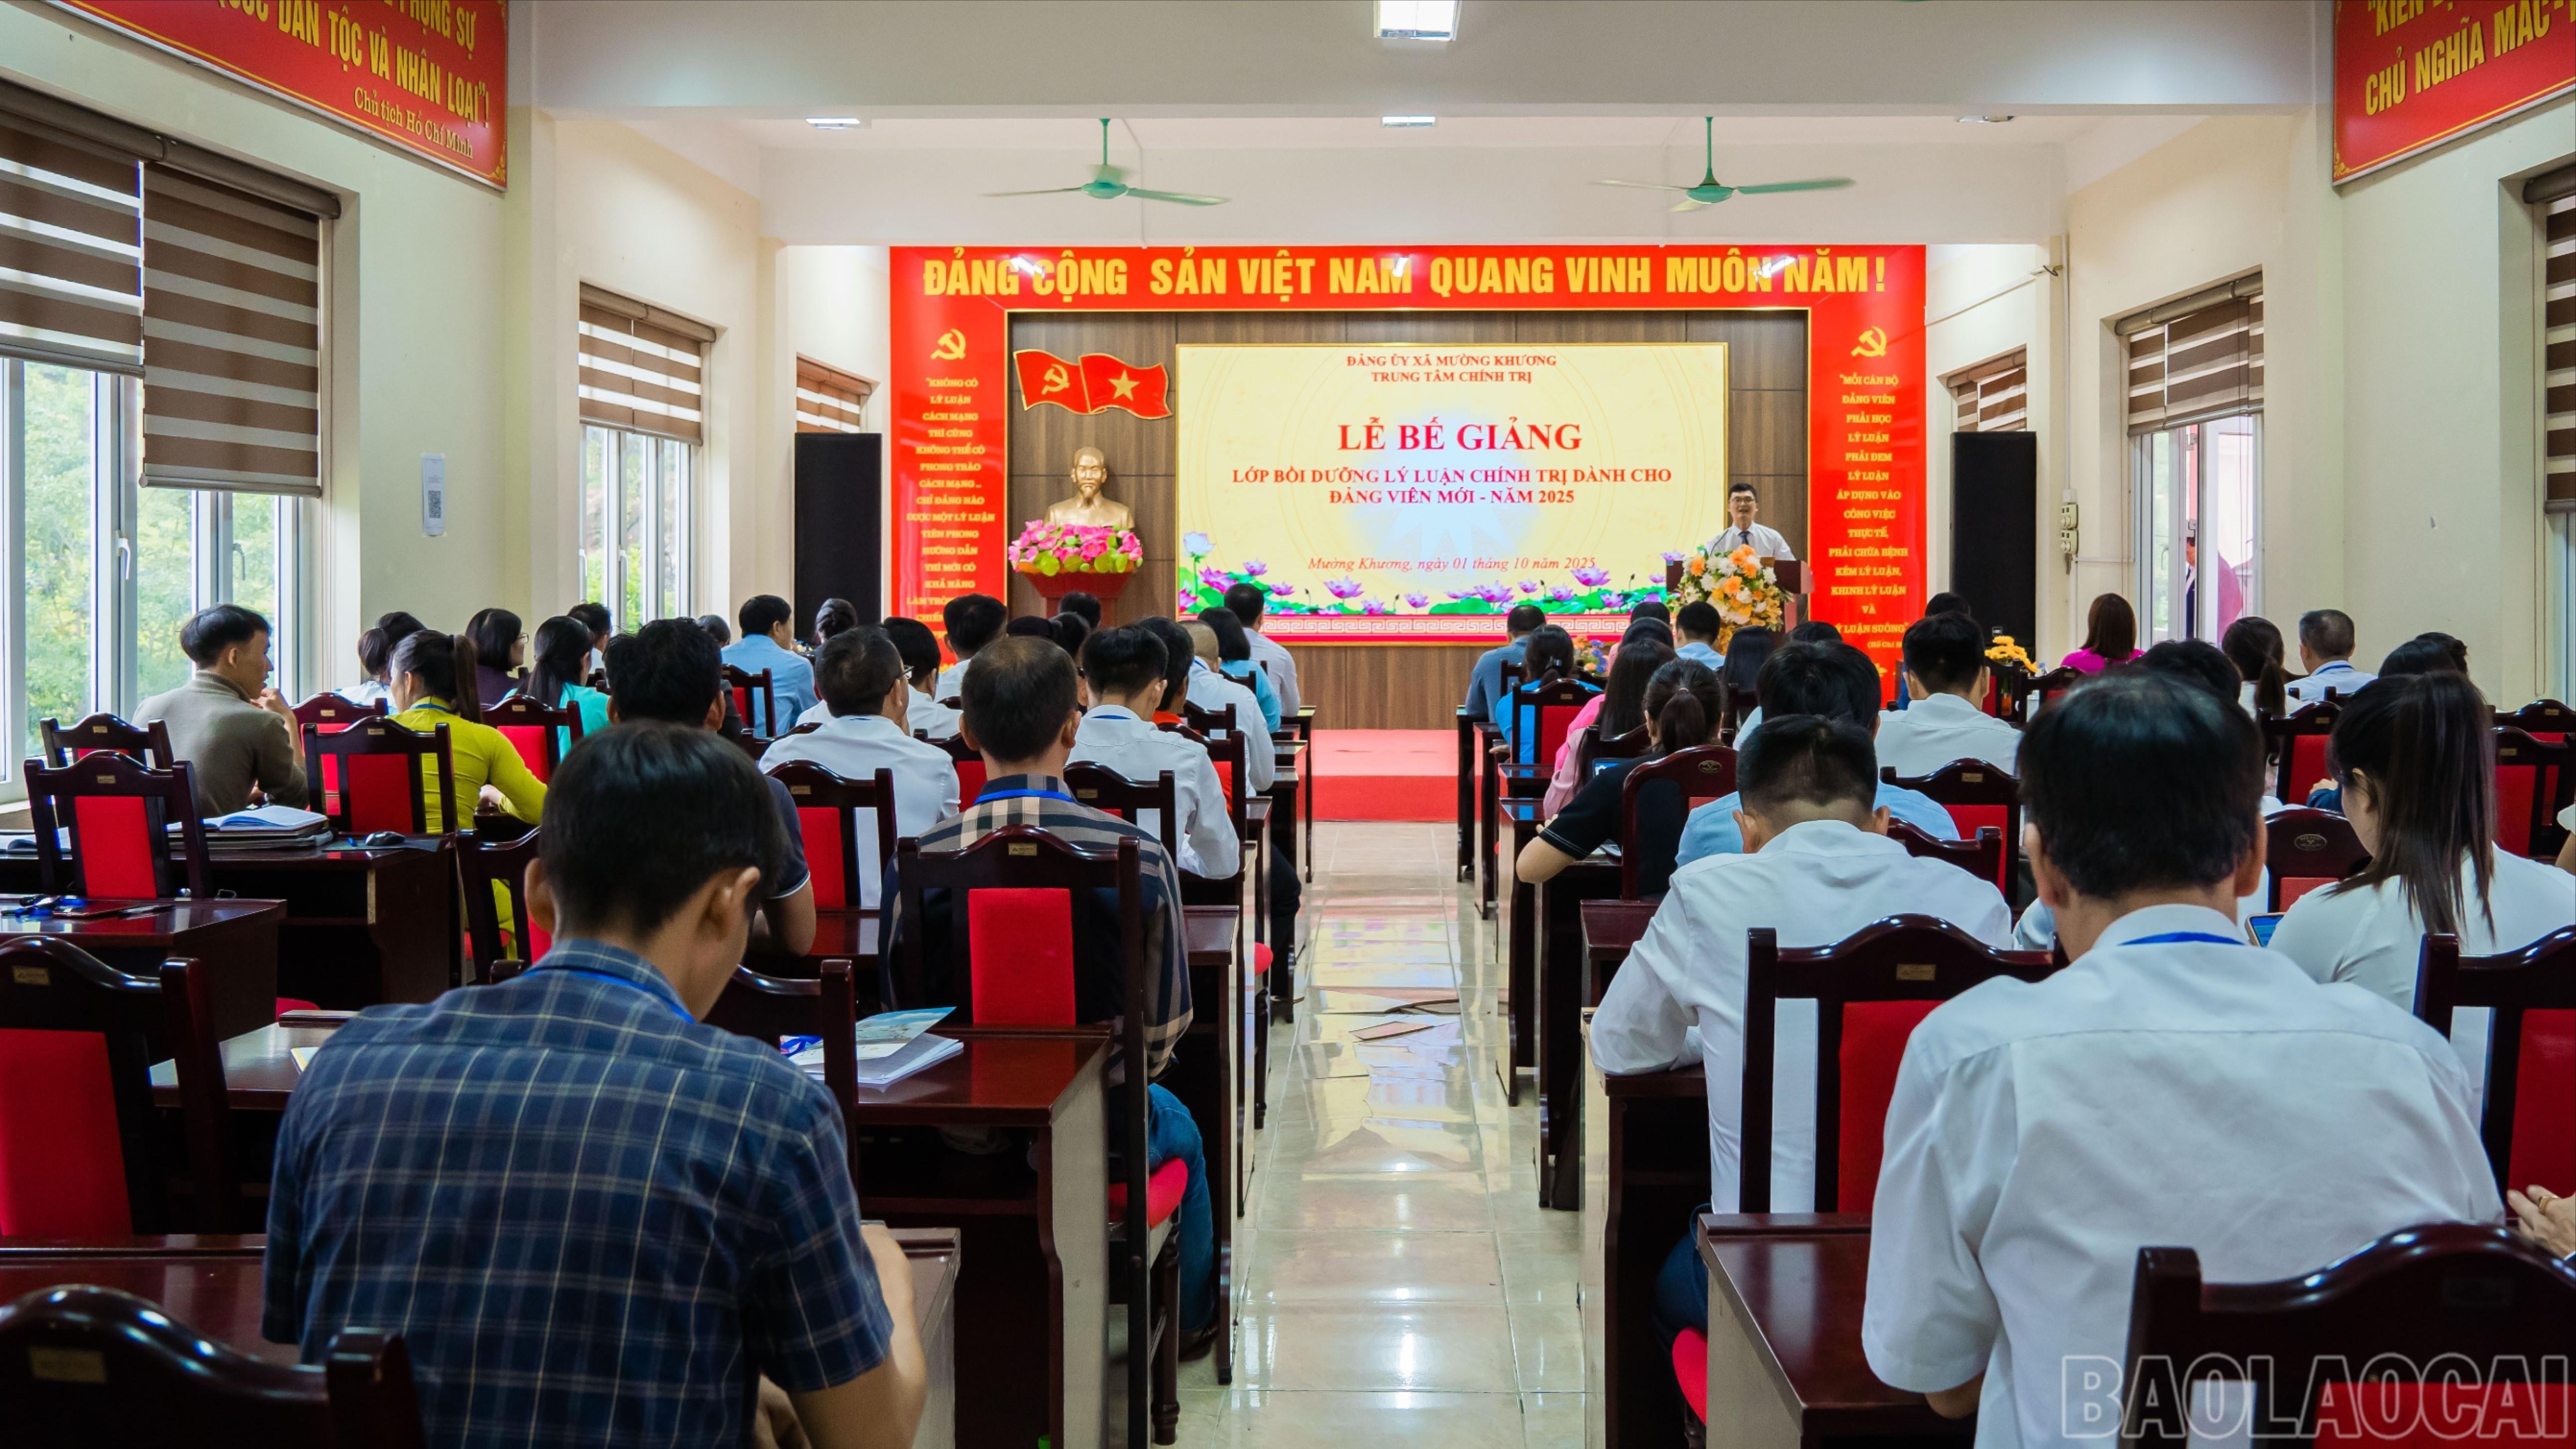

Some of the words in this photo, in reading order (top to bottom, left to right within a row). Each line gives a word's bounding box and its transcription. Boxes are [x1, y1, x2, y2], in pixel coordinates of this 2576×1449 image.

[456, 6, 476, 60] SỰ
[328, 5, 362, 71] TỘC
[369, 25, 390, 80] VÀ
[396, 46, 441, 104] NHÂN
[2365, 46, 2407, 116] CHỦ
[2416, 16, 2485, 94] NGHĨA
[354, 87, 378, 117] Chủ
[381, 99, 403, 128] tịch
[406, 110, 422, 136] Hồ
[425, 120, 444, 146] Chí
[446, 129, 472, 159] Minh
[923, 246, 1019, 296] ĐẢNG
[1032, 250, 1127, 302] CỘNG
[1150, 245, 1226, 295] SẢN
[1238, 250, 1315, 302] VIỆT
[1329, 258, 1412, 293] NAM
[1430, 257, 1554, 298] QUANG
[1565, 257, 1650, 292] VINH
[1666, 248, 1772, 293] MUÔN
[1347, 354, 1387, 366] ĐẢNG
[1390, 353, 1409, 366] ỦY
[1413, 354, 1432, 366] XÃ
[1436, 354, 1490, 366] MƯỜNG
[1494, 354, 1557, 366] KHƯƠNG
[1371, 372, 1420, 382] TRUNG
[1424, 370, 1455, 382] TÂM
[1459, 370, 1505, 383] CHÍNH
[1508, 372, 1531, 384] TRỊ
[1885, 374, 1899, 387] BỘ
[944, 395, 971, 405] LUẬN
[1842, 392, 1870, 404] ĐẢNG
[922, 412, 948, 421] CÁCH
[949, 413, 979, 422] MẠNG
[1846, 411, 1870, 423] PHẢI
[1871, 415, 1892, 425] HỌC
[1338, 416, 1386, 451] LỄ
[1397, 416, 1445, 451] BẾ
[1456, 416, 1583, 451] GIẢNG
[1848, 431, 1861, 442] LÝ
[1862, 432, 1890, 443] LUẬN
[1845, 449, 1869, 461] PHẢI
[920, 462, 954, 471] PHONG
[1232, 466, 1270, 483] LỚP
[1273, 466, 1305, 483] BỒI
[1311, 466, 1379, 483] DƯỠNG
[1384, 466, 1409, 483] LÝ
[1414, 467, 1465, 485] LUẬN
[1470, 466, 1530, 483] CHÍNH
[1537, 469, 1568, 486] TRỊ
[1573, 466, 1626, 482] DÀNH
[1630, 468, 1672, 482] CHO
[1848, 470, 1861, 481] LÝ
[1862, 470, 1890, 482] LUẬN
[919, 479, 945, 488] CÁCH
[946, 480, 975, 489] MẠNG
[1329, 487, 1382, 504] ĐẢNG
[1387, 487, 1432, 504] VIÊN
[1437, 487, 1474, 503] MỚI
[1490, 487, 1533, 503] NĂM
[1538, 489, 1575, 504] 2025
[1851, 490, 1879, 501] DỤNG
[1880, 489, 1902, 500] VÀO
[968, 512, 995, 523] LUẬN
[1843, 508, 1871, 519] CÔNG
[1872, 508, 1896, 520] VIỆC
[945, 530, 979, 538] PHONG
[1829, 545, 1852, 557] PHẢI
[1881, 546, 1909, 558] BỆNH
[1308, 557, 1355, 572] Mường
[1358, 557, 1413, 572] Khương,
[1417, 558, 1448, 572] ngày
[1453, 557, 1467, 569] 01
[1473, 558, 1509, 572] tháng
[1514, 558, 1529, 569] 10
[1532, 558, 1560, 569] năm
[1564, 557, 1596, 569] 2025
[1835, 566, 1857, 576] KÉM
[1858, 566, 1872, 576] LÝ
[1831, 586, 1864, 595] KHINH
[1864, 585, 1878, 595] LÝ
[1879, 584, 1906, 596] LUẬN
[1862, 603, 1876, 614] VÀ
[1843, 623, 1871, 635] LUẬN
